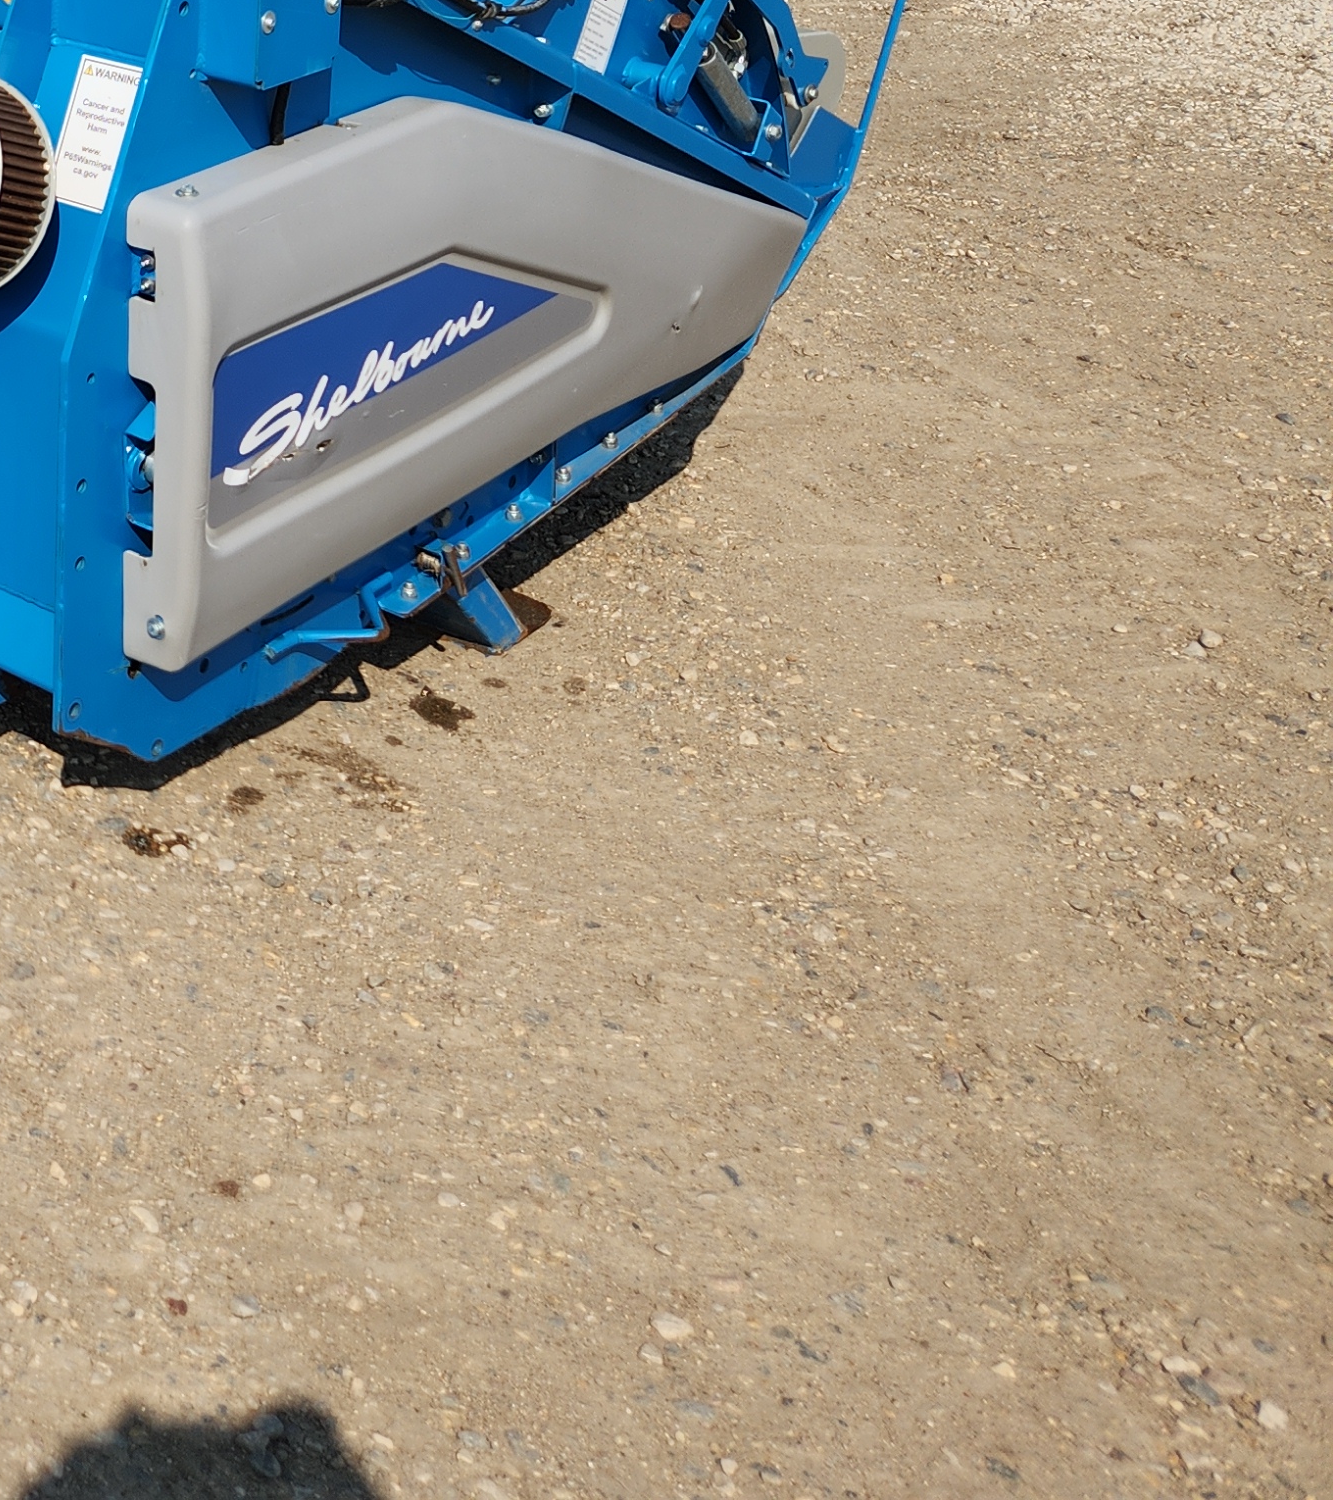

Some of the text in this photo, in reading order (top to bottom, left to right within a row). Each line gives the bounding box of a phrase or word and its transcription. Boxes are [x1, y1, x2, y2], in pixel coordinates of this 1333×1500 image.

[95, 67, 141, 86] WARNING
[82, 98, 125, 115] Cancer and
[76, 108, 125, 127] Reproductive
[87, 123, 108, 134] Harm
[63, 151, 113, 172] P65Warnings.
[222, 300, 495, 486] Shelbourne
